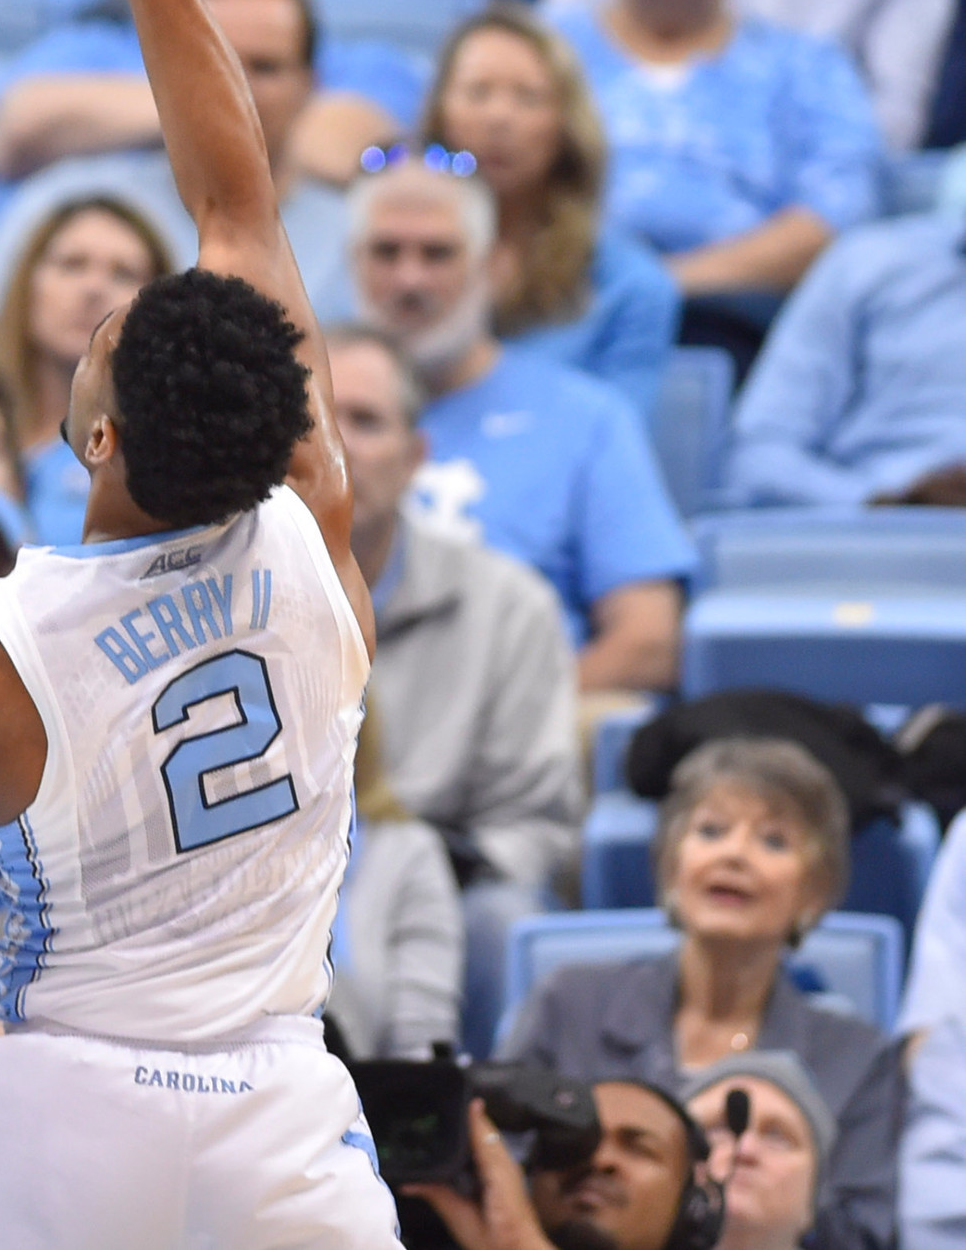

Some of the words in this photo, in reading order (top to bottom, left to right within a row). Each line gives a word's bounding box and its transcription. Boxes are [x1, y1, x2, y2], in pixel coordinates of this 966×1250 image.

[140, 545, 203, 579] ACC
[94, 574, 233, 685] BERRY
[249, 569, 272, 630] II
[151, 648, 300, 855] 2
[134, 1065, 254, 1094] CAROLINA
